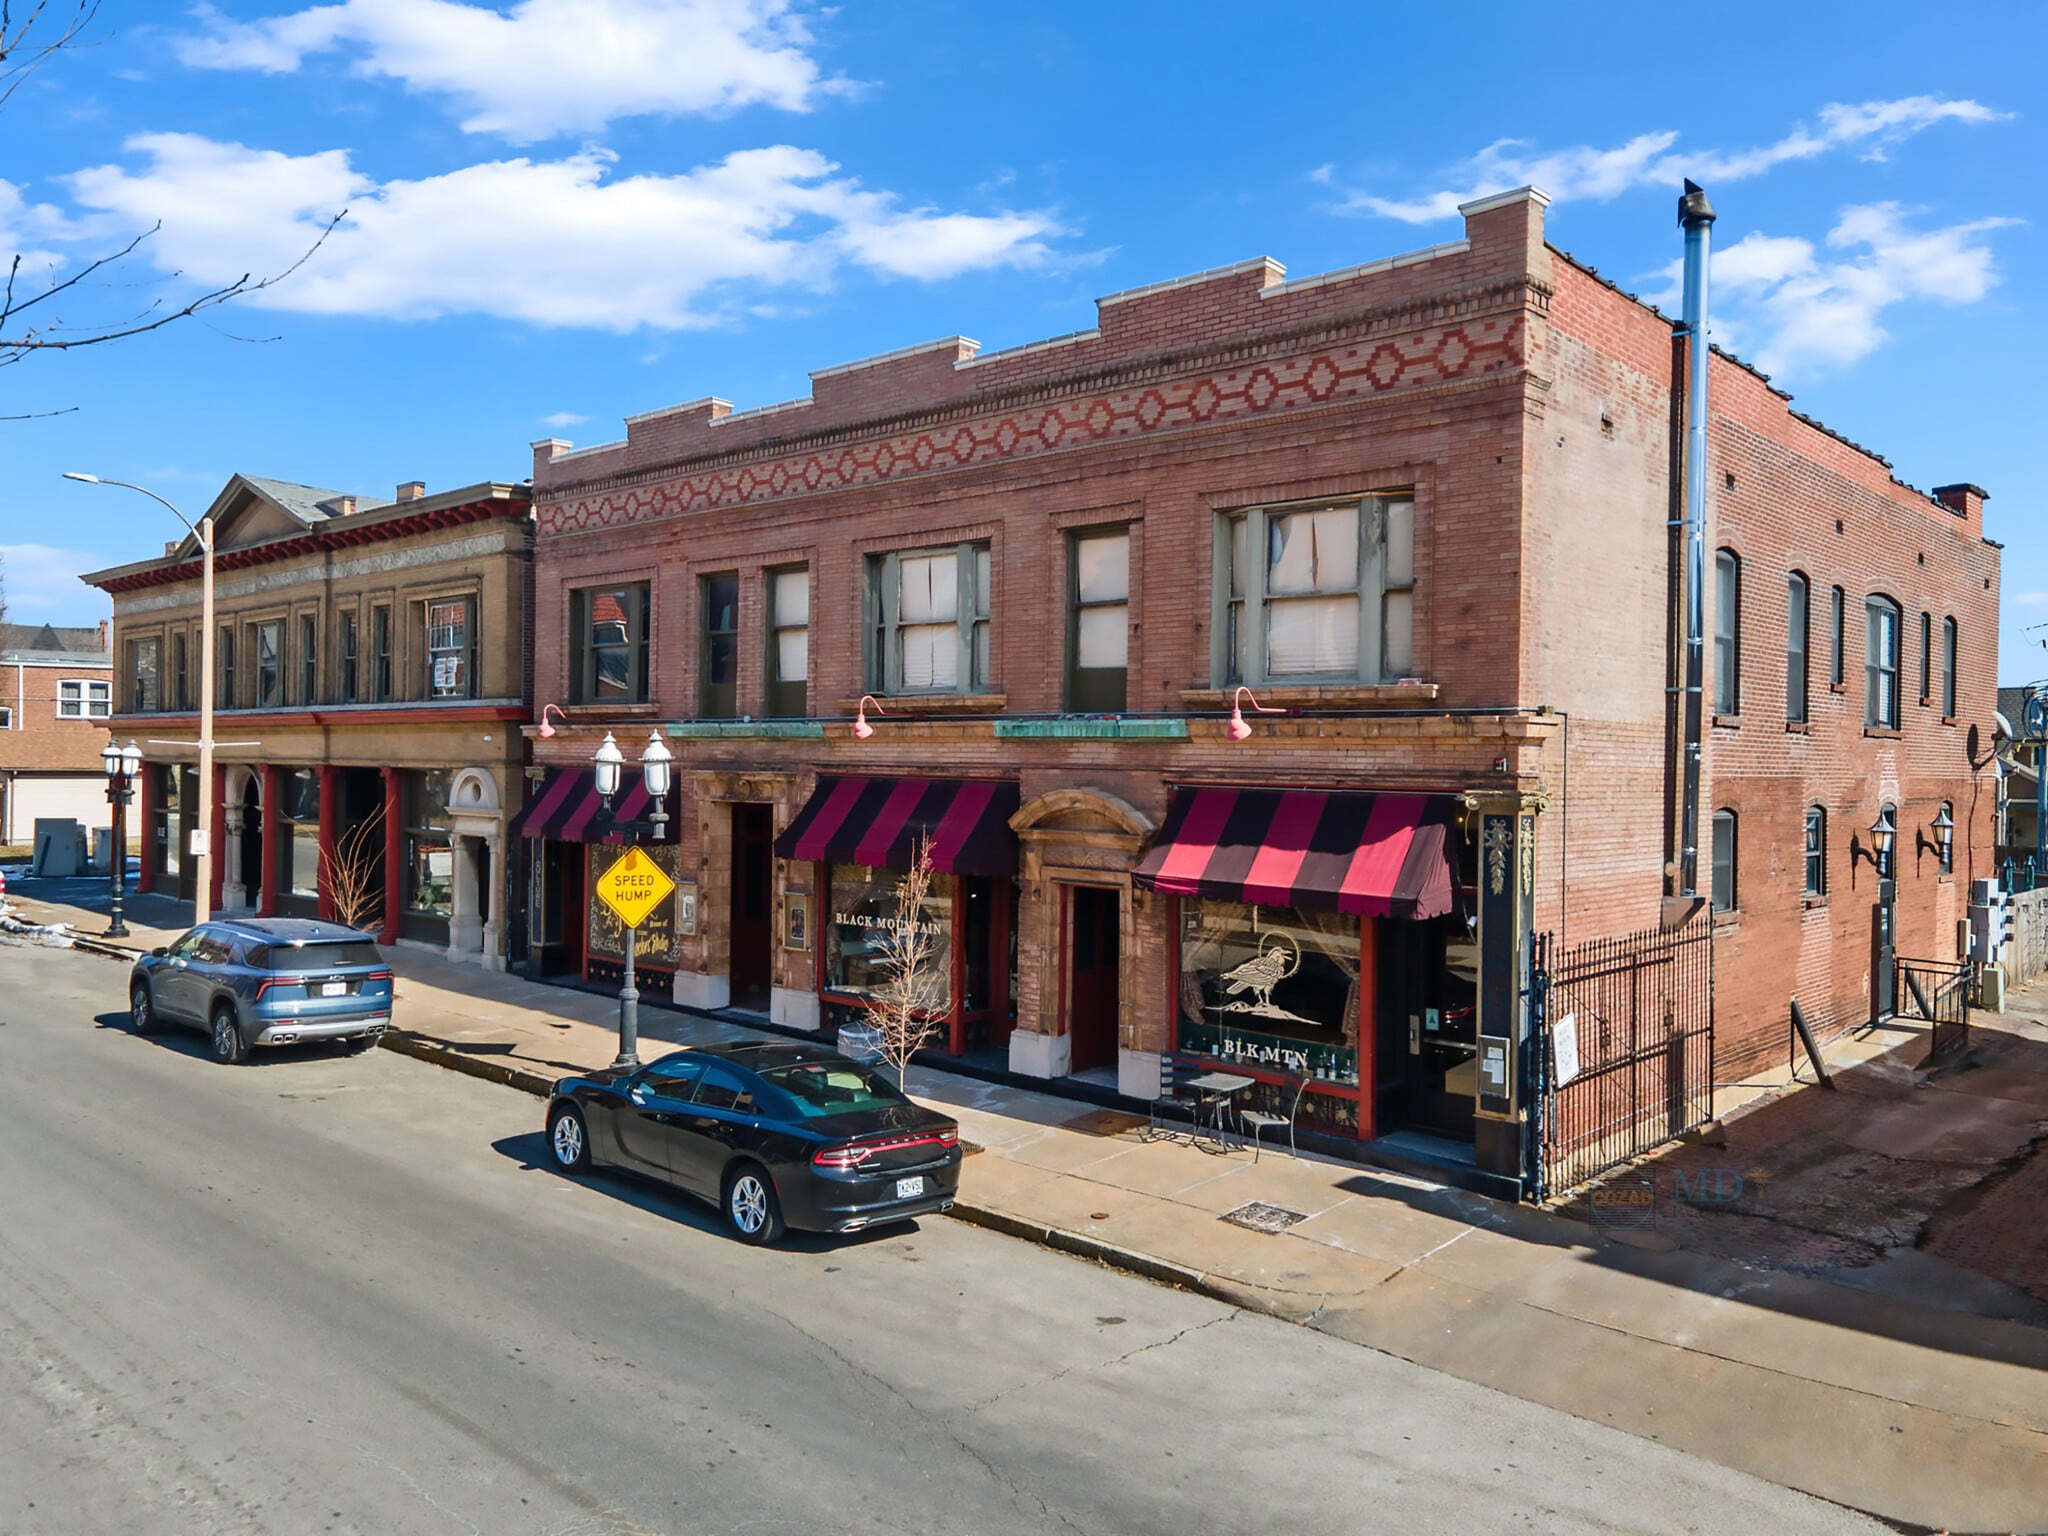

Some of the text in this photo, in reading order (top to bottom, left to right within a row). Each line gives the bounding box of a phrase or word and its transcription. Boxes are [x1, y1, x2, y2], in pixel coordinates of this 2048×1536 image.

[614, 874, 655, 887] SPEED
[615, 889, 652, 902] HUMP
[835, 912, 873, 927] BLACK
[1223, 1039, 1308, 1068] BLK MTN
